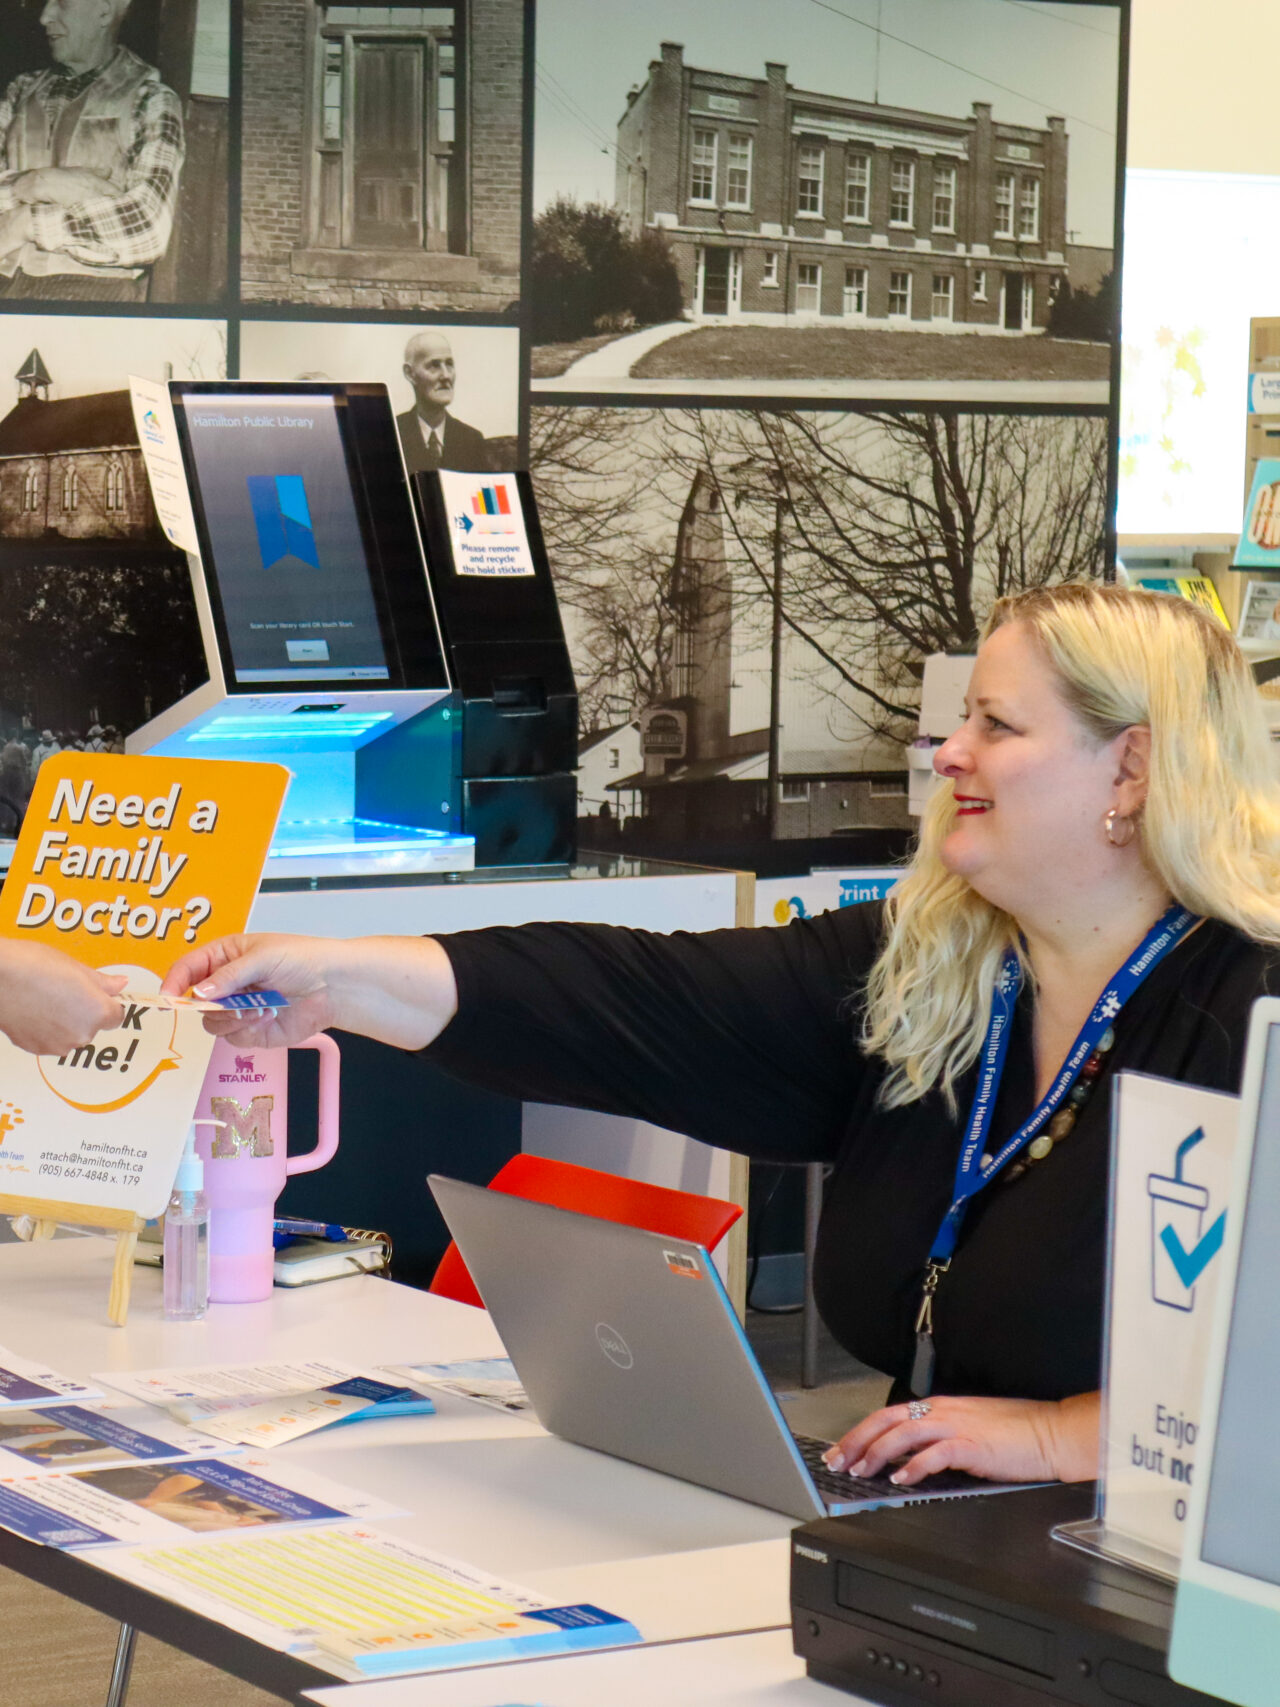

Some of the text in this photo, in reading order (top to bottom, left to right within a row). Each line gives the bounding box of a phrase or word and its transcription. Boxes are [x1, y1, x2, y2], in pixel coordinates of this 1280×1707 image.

[193, 415, 314, 430] Hamilton Public Library
[461, 543, 520, 553] Please remove
[470, 554, 515, 565] and recycle
[463, 566, 528, 574] the hold sticker.
[48, 778, 219, 834] Need a
[32, 831, 188, 899] Family
[16, 883, 212, 944] Doctor?
[1128, 932, 1172, 977] Hamilton
[57, 1038, 140, 1073] me!
[218, 1074, 267, 1083] STANLEY
[961, 1015, 1005, 1172] Hamilton Family Health Team
[982, 1041, 1090, 1179] Hamilton Family Health Team
[210, 1095, 274, 1159] M
[9, 1151, 24, 1161] Team
[39, 1151, 144, 1173] attach@hamiltonfht.ca
[80, 1140, 148, 1159] hamiltonfht.ca
[38, 1163, 140, 1187] (905) 667-4848 x. 179
[1156, 1404, 1199, 1450] Enjo
[1131, 1433, 1165, 1475] but
[794, 1544, 828, 1564] PHILIPS
